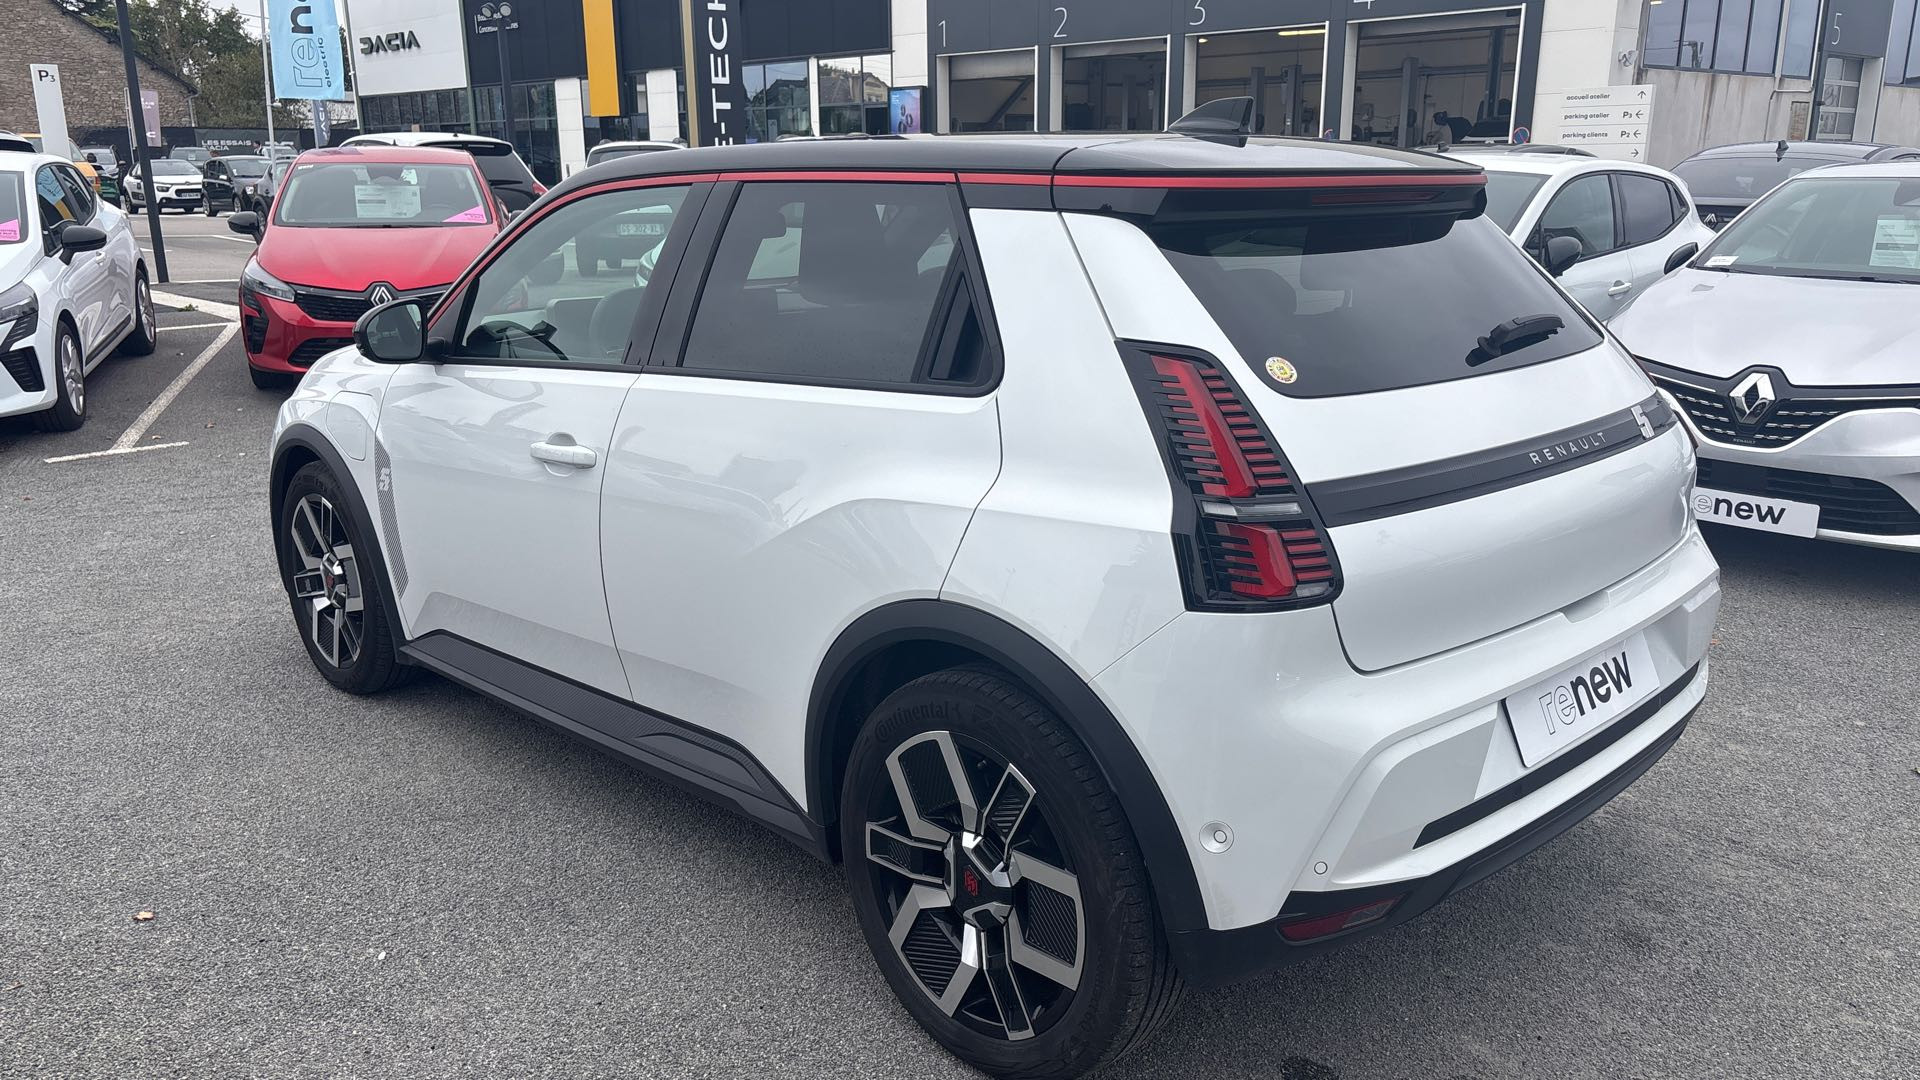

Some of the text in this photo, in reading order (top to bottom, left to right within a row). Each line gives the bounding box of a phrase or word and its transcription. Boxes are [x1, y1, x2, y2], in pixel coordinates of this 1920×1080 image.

[938, 20, 946, 48] 1
[1053, 7, 1068, 38] 2
[1831, 13, 1842, 45] 5
[290, 0, 323, 87] ren
[359, 30, 421, 55] DACIA
[318, 37, 331, 88] electric
[1566, 93, 1589, 101] accueil
[1529, 432, 1606, 464] RENAULT
[1693, 494, 1787, 525] enew
[1539, 651, 1632, 735] renew
[874, 700, 949, 742] Continental
